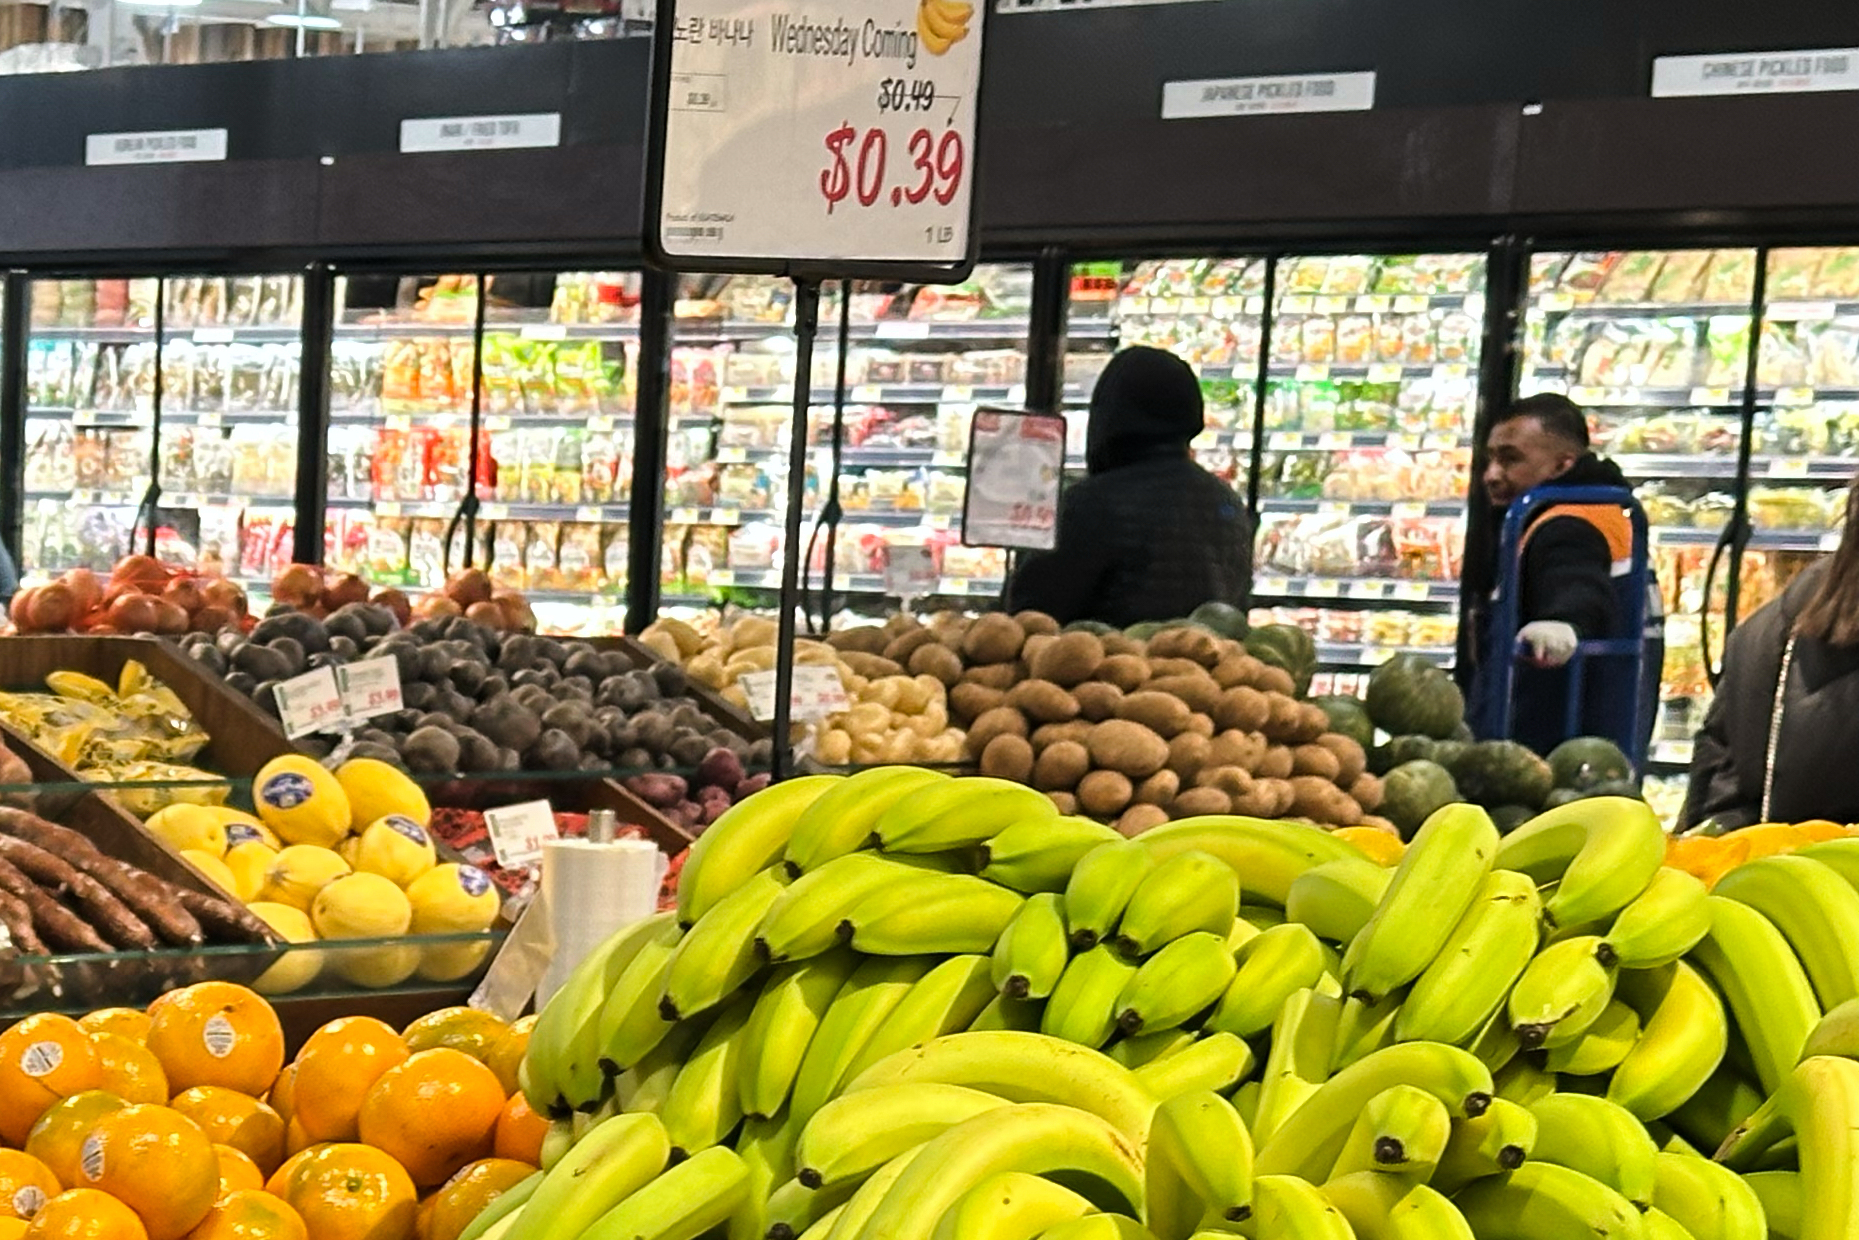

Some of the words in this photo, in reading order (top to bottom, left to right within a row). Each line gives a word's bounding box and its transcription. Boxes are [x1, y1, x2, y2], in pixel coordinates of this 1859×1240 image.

[771, 13, 858, 67] Wednesday
[862, 18, 918, 69] Coming
[878, 77, 935, 115] $0.49
[820, 120, 964, 215] $0.39
[925, 226, 933, 243] 1
[936, 226, 954, 243] LB
